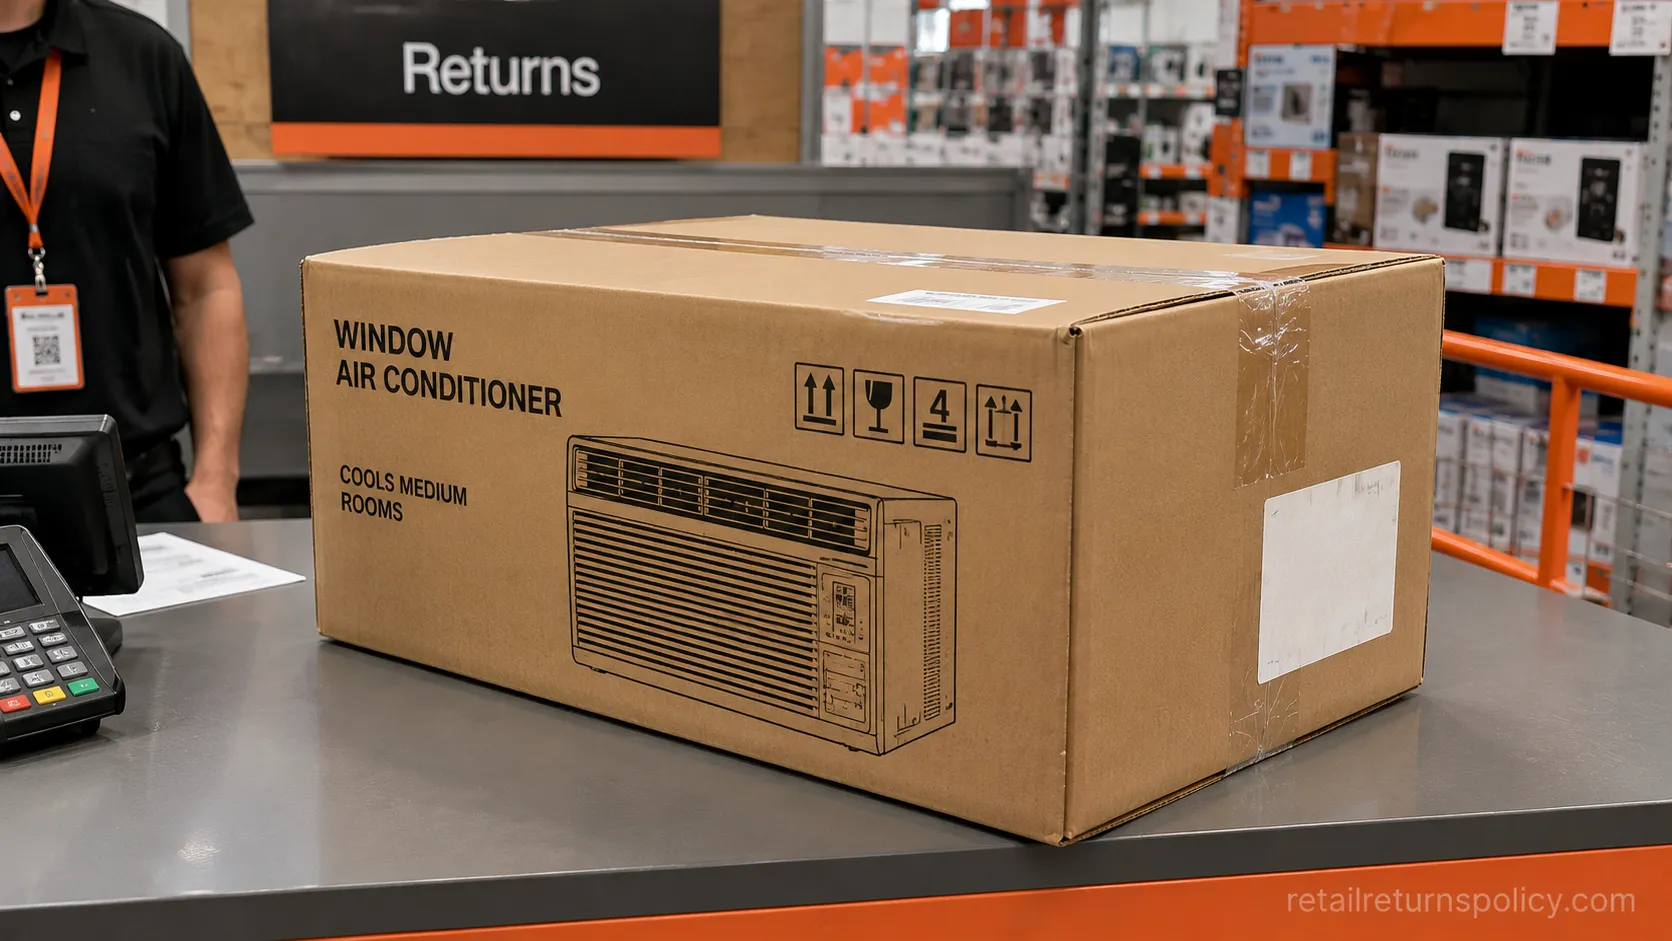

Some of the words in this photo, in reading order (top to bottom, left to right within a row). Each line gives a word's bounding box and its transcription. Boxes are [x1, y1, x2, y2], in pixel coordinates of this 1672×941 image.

[403, 41, 601, 97] Returns
[334, 319, 453, 361] WINDOW
[336, 359, 376, 390] AIR
[384, 365, 562, 417] CONDITIONER
[930, 389, 950, 423] 4
[340, 465, 394, 492] COOLS
[400, 475, 467, 506] MEDIUM
[341, 492, 403, 521] ROOMS
